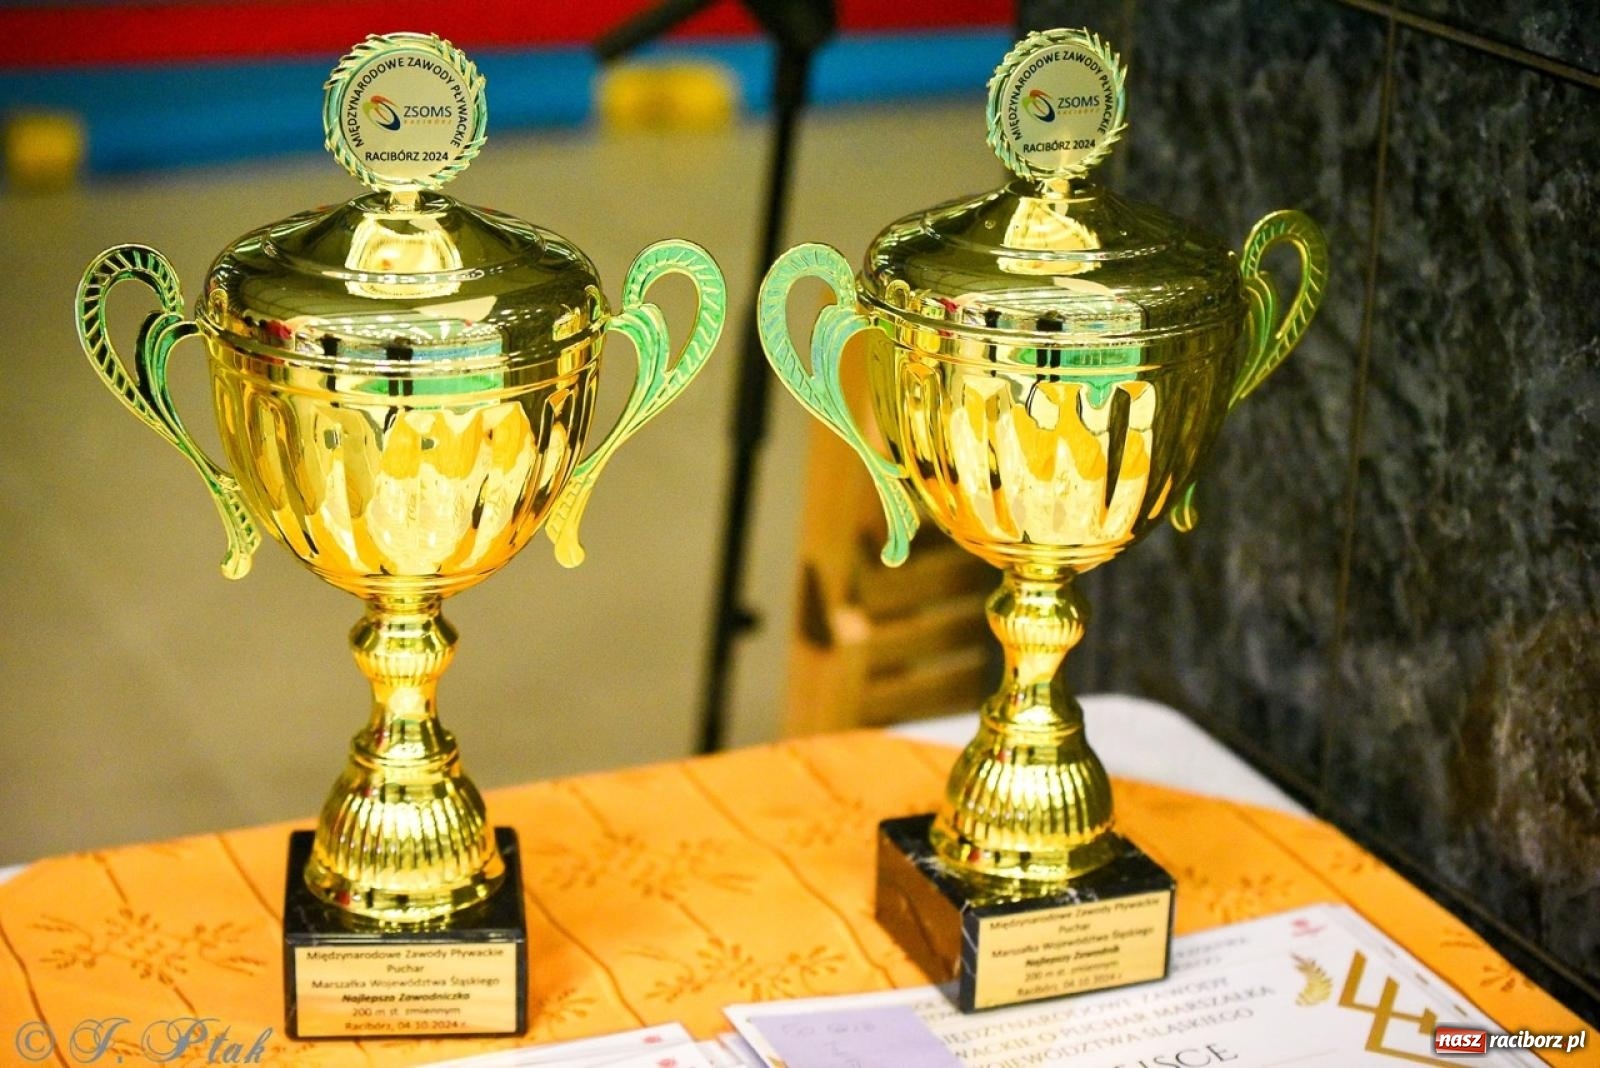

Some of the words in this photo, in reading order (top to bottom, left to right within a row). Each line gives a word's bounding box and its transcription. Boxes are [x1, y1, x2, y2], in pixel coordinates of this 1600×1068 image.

[347, 57, 404, 147] MIĘDZYNARODOWE
[407, 57, 454, 87] ZAWODY
[450, 84, 468, 148] PŁYWACKIE
[1008, 52, 1060, 141] MIĘDZYNARODOWE
[1062, 51, 1103, 77] ZAWODY
[1097, 74, 1114, 135] PŁYWACKIE
[1057, 95, 1100, 109] ZSOMS
[403, 105, 452, 118] ZSOMS
[1023, 140, 1071, 153] RACIBÓRZ
[1072, 139, 1096, 150] 2024
[365, 150, 420, 161] RACIBÓRZ
[422, 151, 449, 161] 2024
[306, 950, 402, 962] Międzynarodowe
[404, 949, 447, 960] Zawody
[450, 948, 505, 959] Pływackie
[386, 963, 425, 974] Puchar
[311, 978, 367, 989] Marszałka
[370, 976, 447, 990] Województwa
[450, 974, 501, 988] Śląskiego
[341, 993, 396, 1004] Najlepsza
[398, 991, 471, 1002] Zawodniczka
[352, 1007, 372, 1017] 200
[375, 1008, 386, 1016] m
